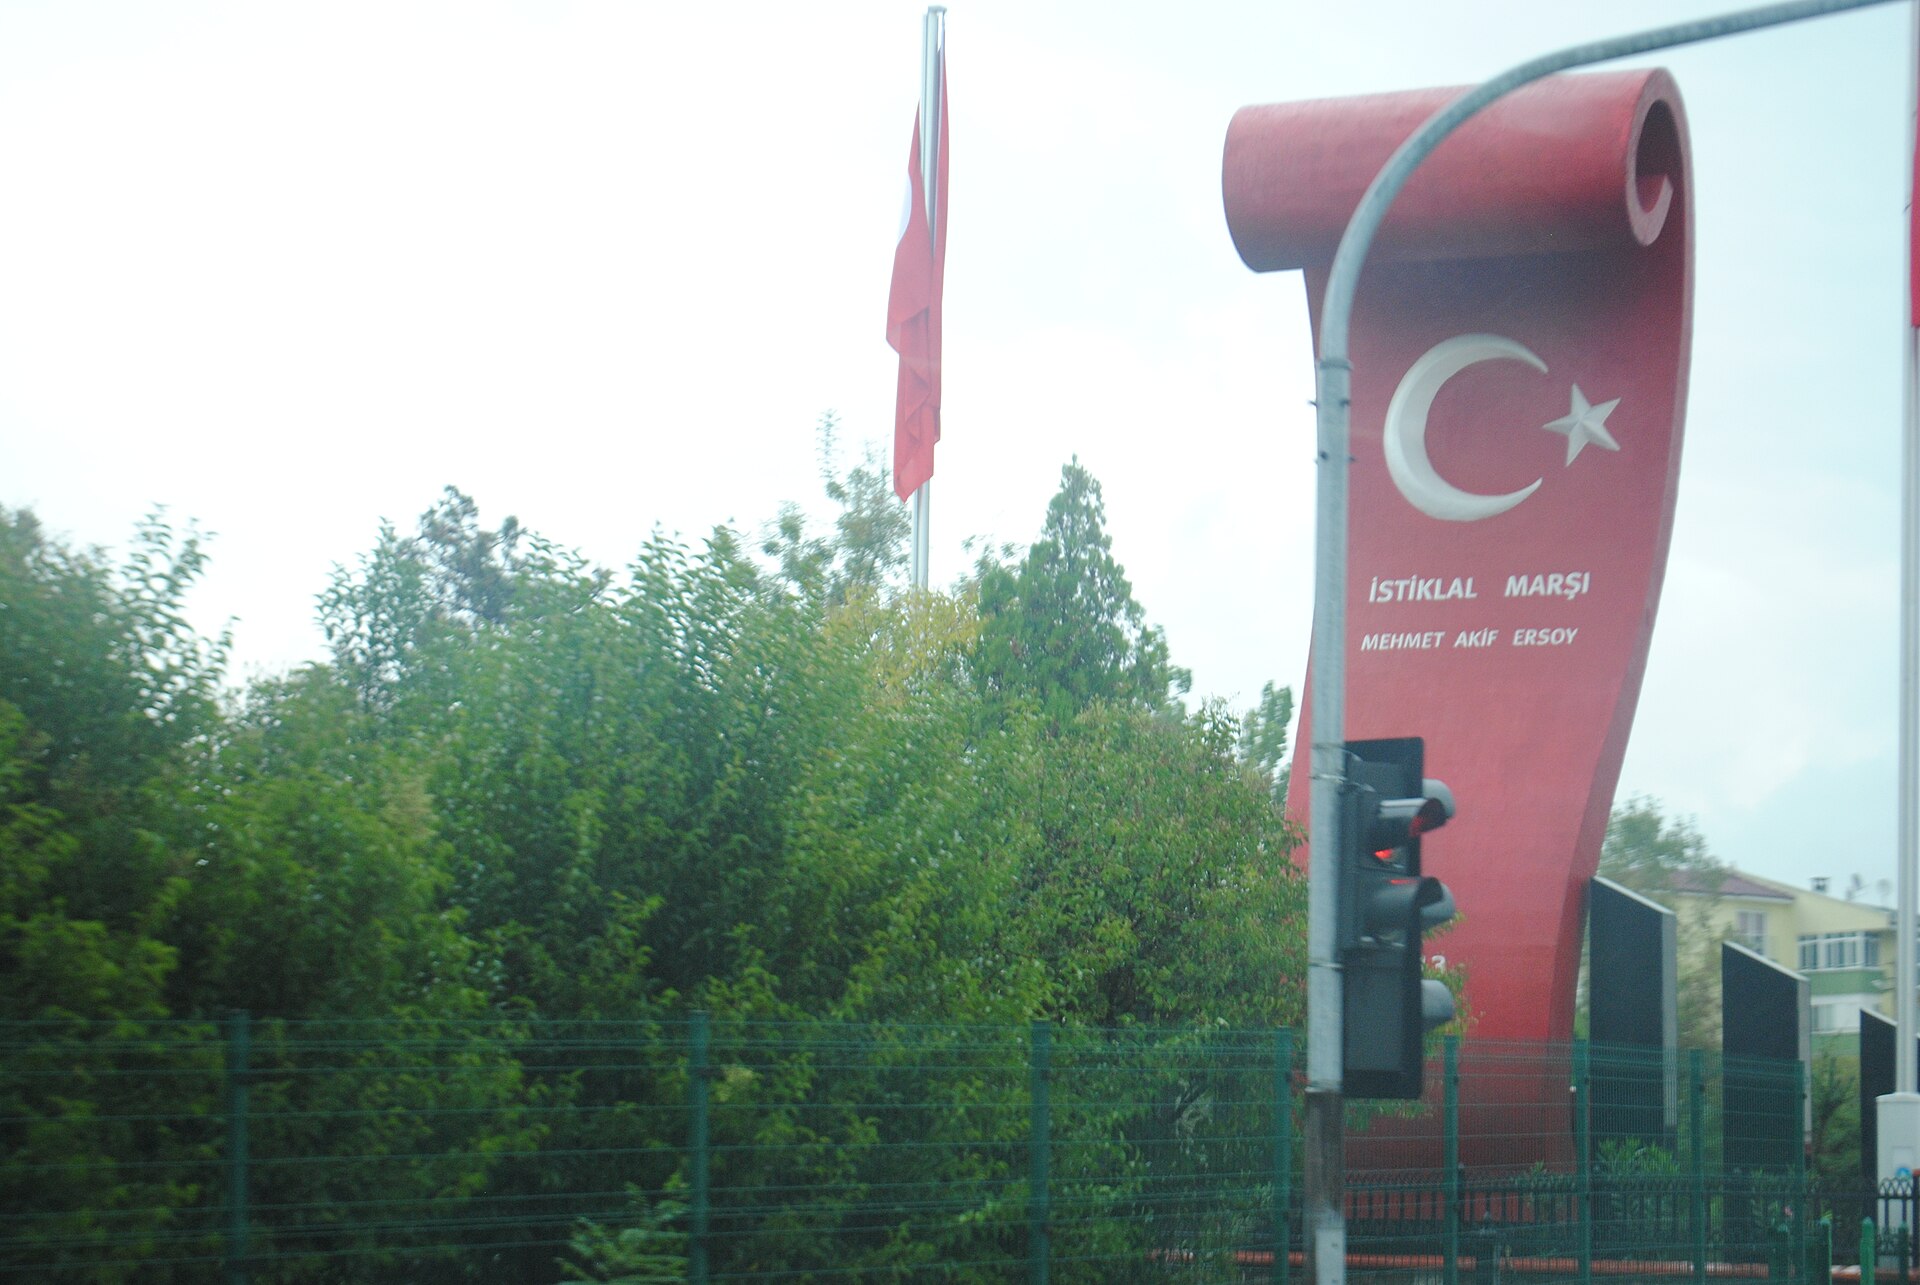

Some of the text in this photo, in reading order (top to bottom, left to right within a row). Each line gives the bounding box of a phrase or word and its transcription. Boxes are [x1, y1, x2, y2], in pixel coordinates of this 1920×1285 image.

[1368, 572, 1591, 602] İSTİKLAL MARŞI
[1361, 627, 1579, 651] MEHMET AKİF ERSOY
